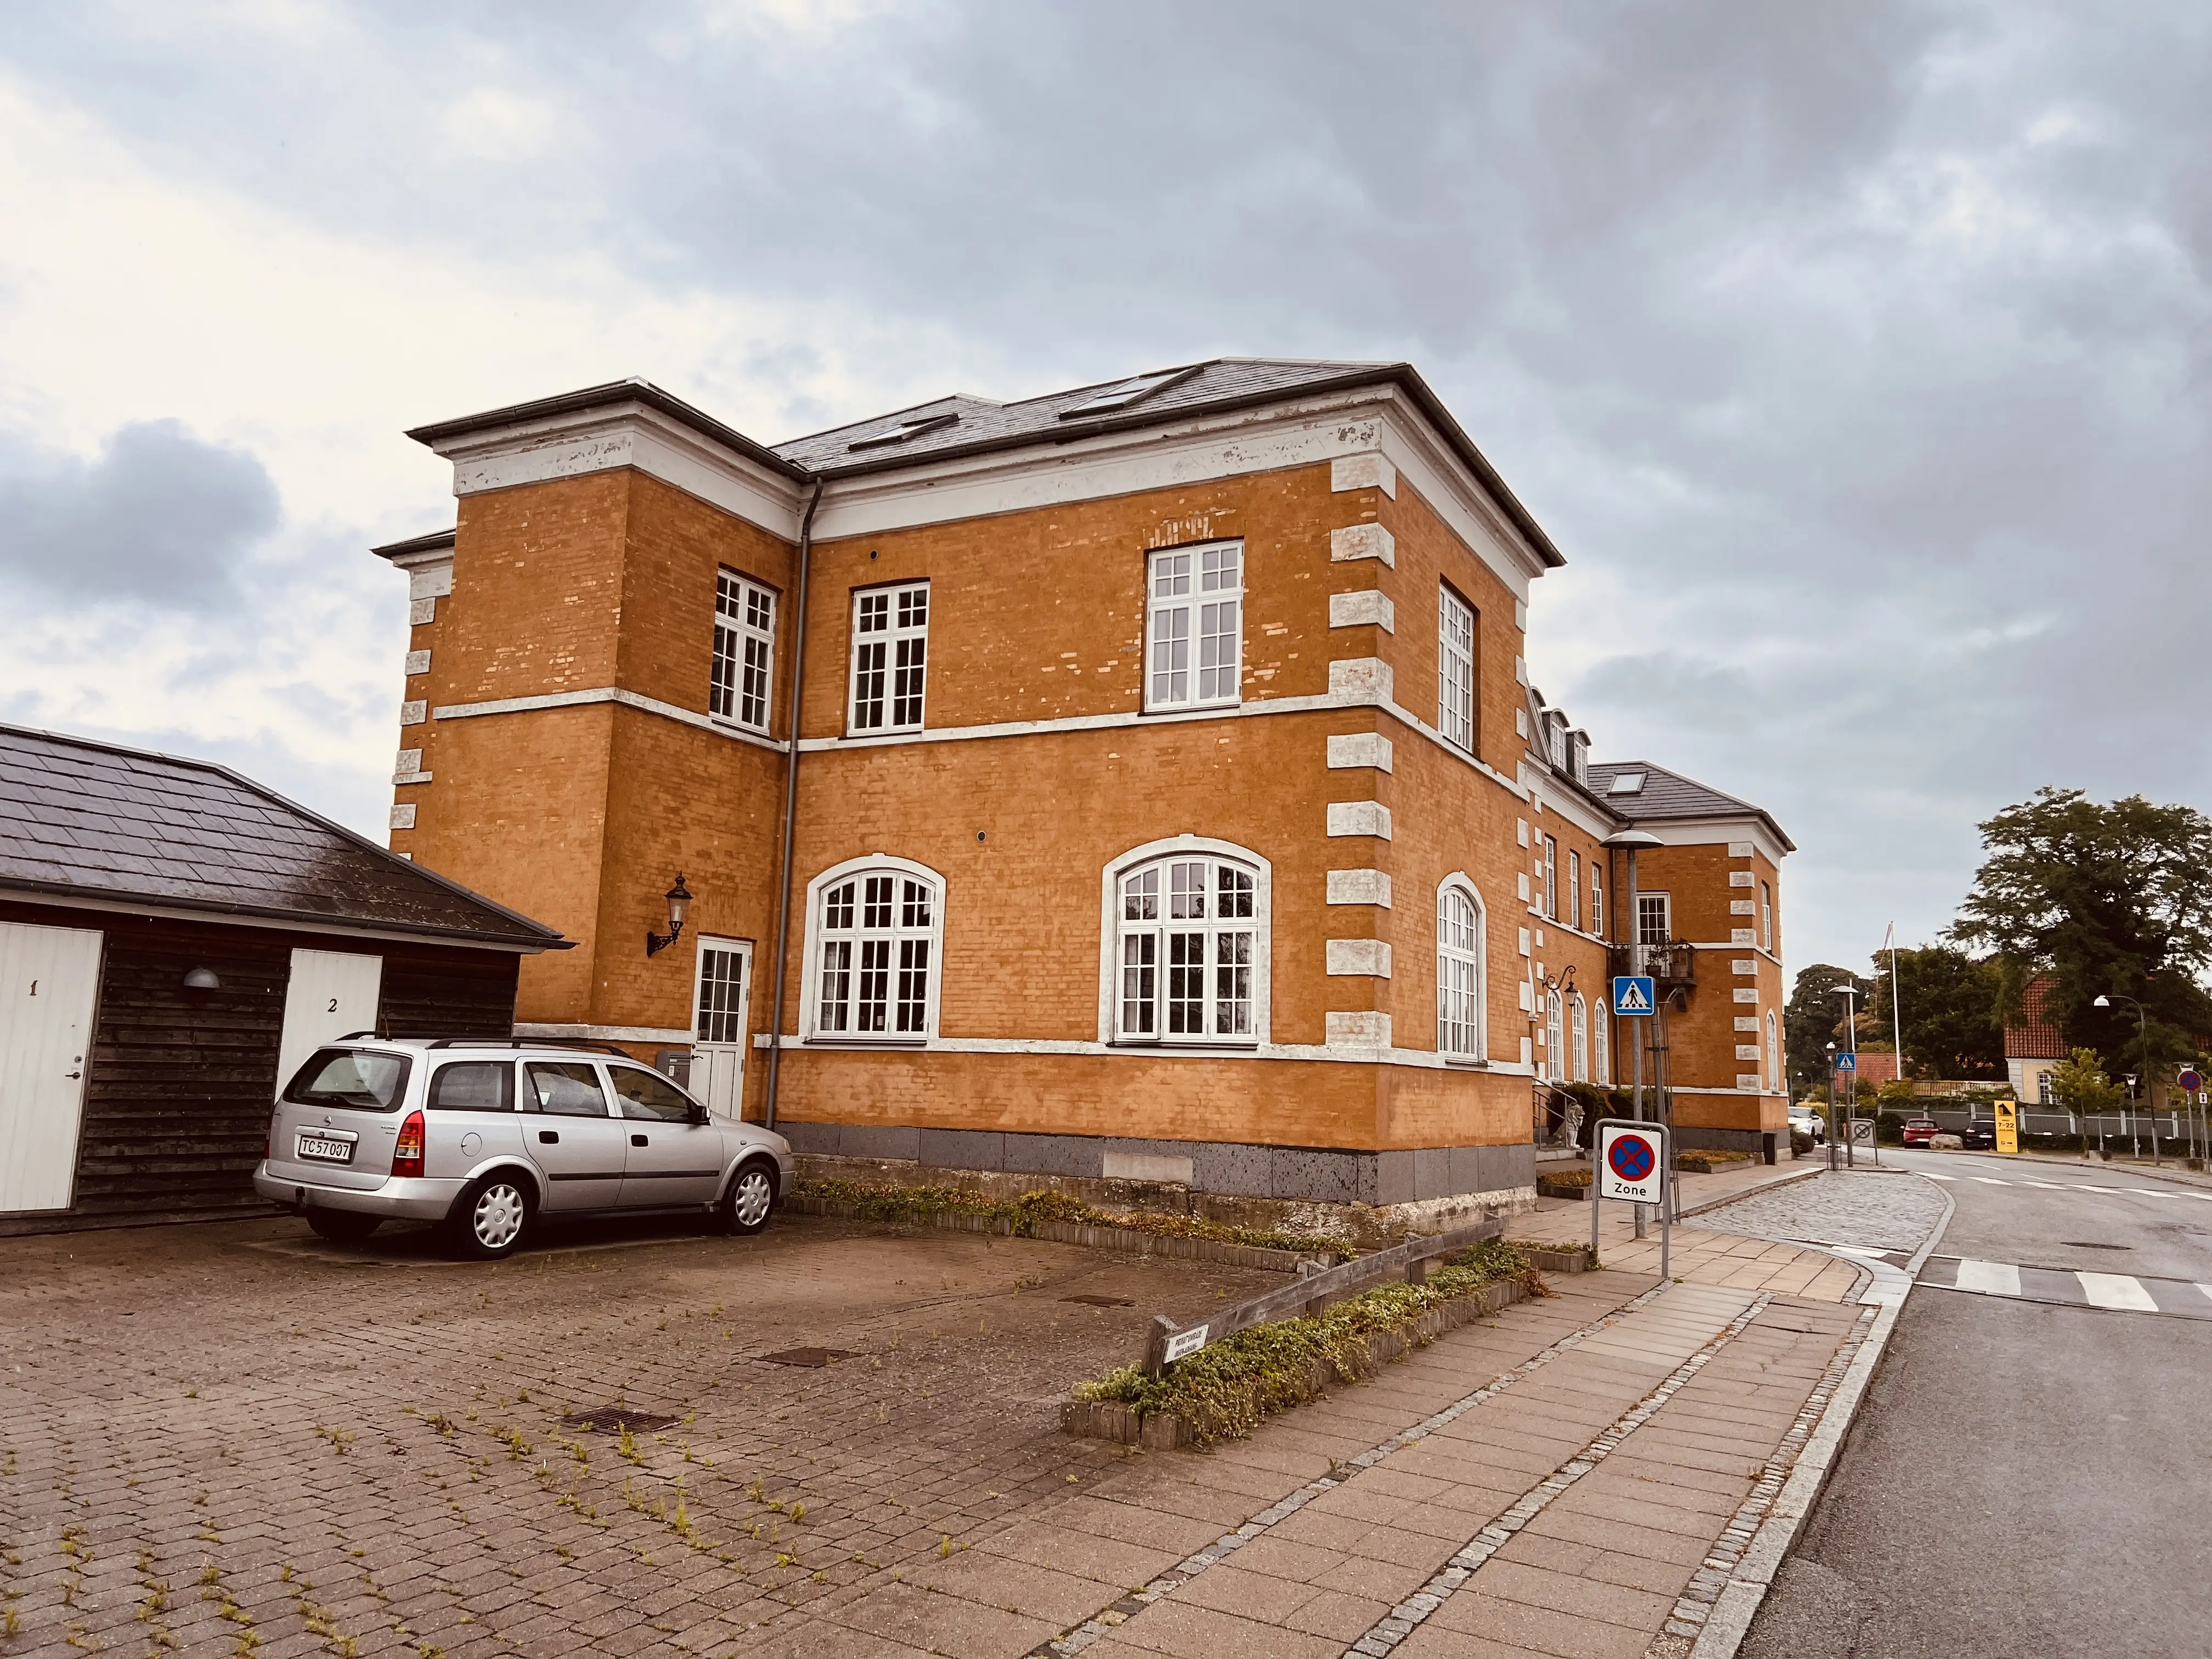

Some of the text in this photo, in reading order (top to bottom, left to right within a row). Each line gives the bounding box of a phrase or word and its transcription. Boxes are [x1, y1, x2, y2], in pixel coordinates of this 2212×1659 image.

[30, 980, 38, 996] 1
[328, 998, 337, 1012] 2
[1615, 1182, 1646, 1196] Zone
